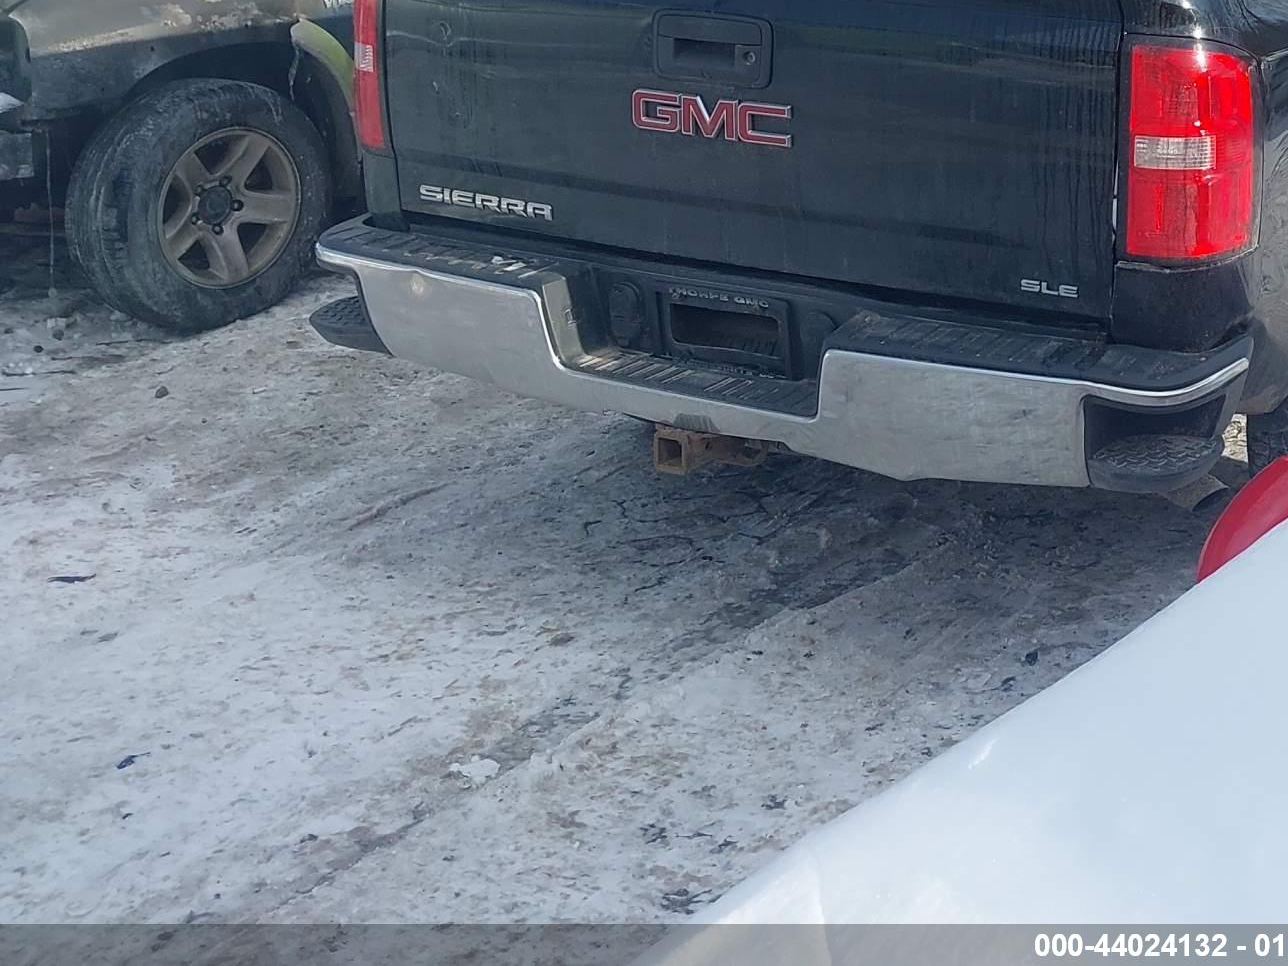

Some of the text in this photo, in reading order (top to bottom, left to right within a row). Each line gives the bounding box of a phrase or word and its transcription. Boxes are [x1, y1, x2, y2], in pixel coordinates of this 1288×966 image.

[632, 89, 793, 148] GMC
[419, 184, 553, 221] SIERRA
[1020, 279, 1079, 299] SLE
